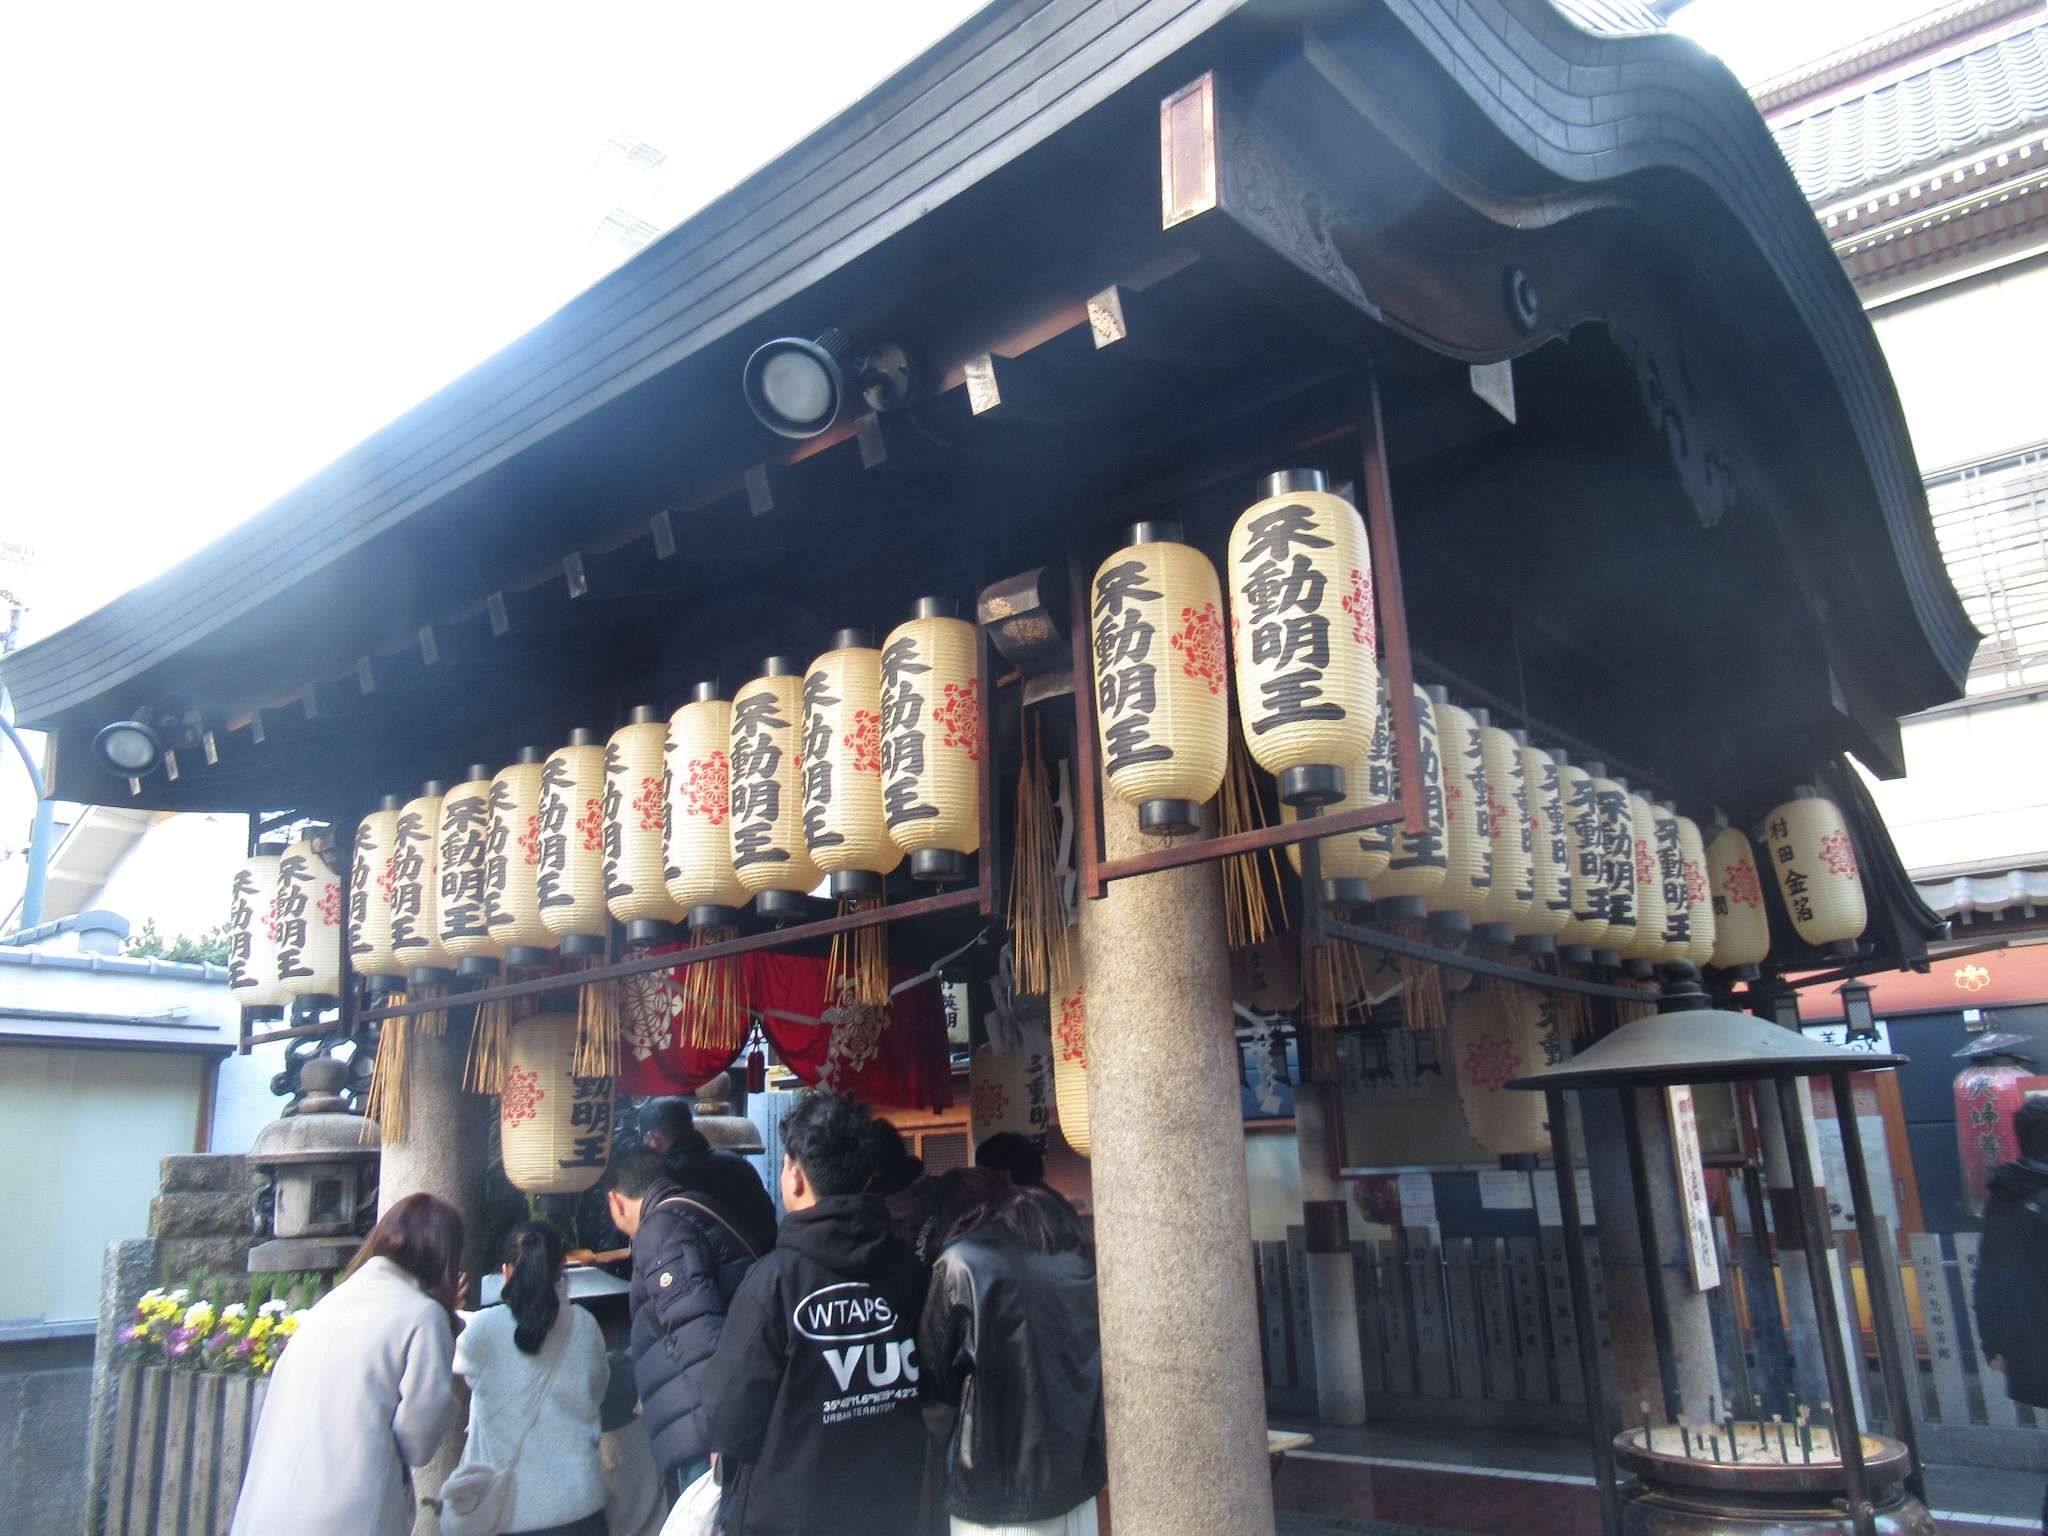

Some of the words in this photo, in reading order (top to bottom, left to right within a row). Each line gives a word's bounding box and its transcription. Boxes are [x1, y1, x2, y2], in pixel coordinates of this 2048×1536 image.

[1093, 560, 1175, 777] 不動明王
[1239, 504, 1347, 737] 不動明王
[731, 692, 792, 872] 不動明王
[439, 796, 491, 942] 不動明王
[1768, 816, 1814, 924] 村田金箔
[808, 1297, 892, 1329] WTAPS
